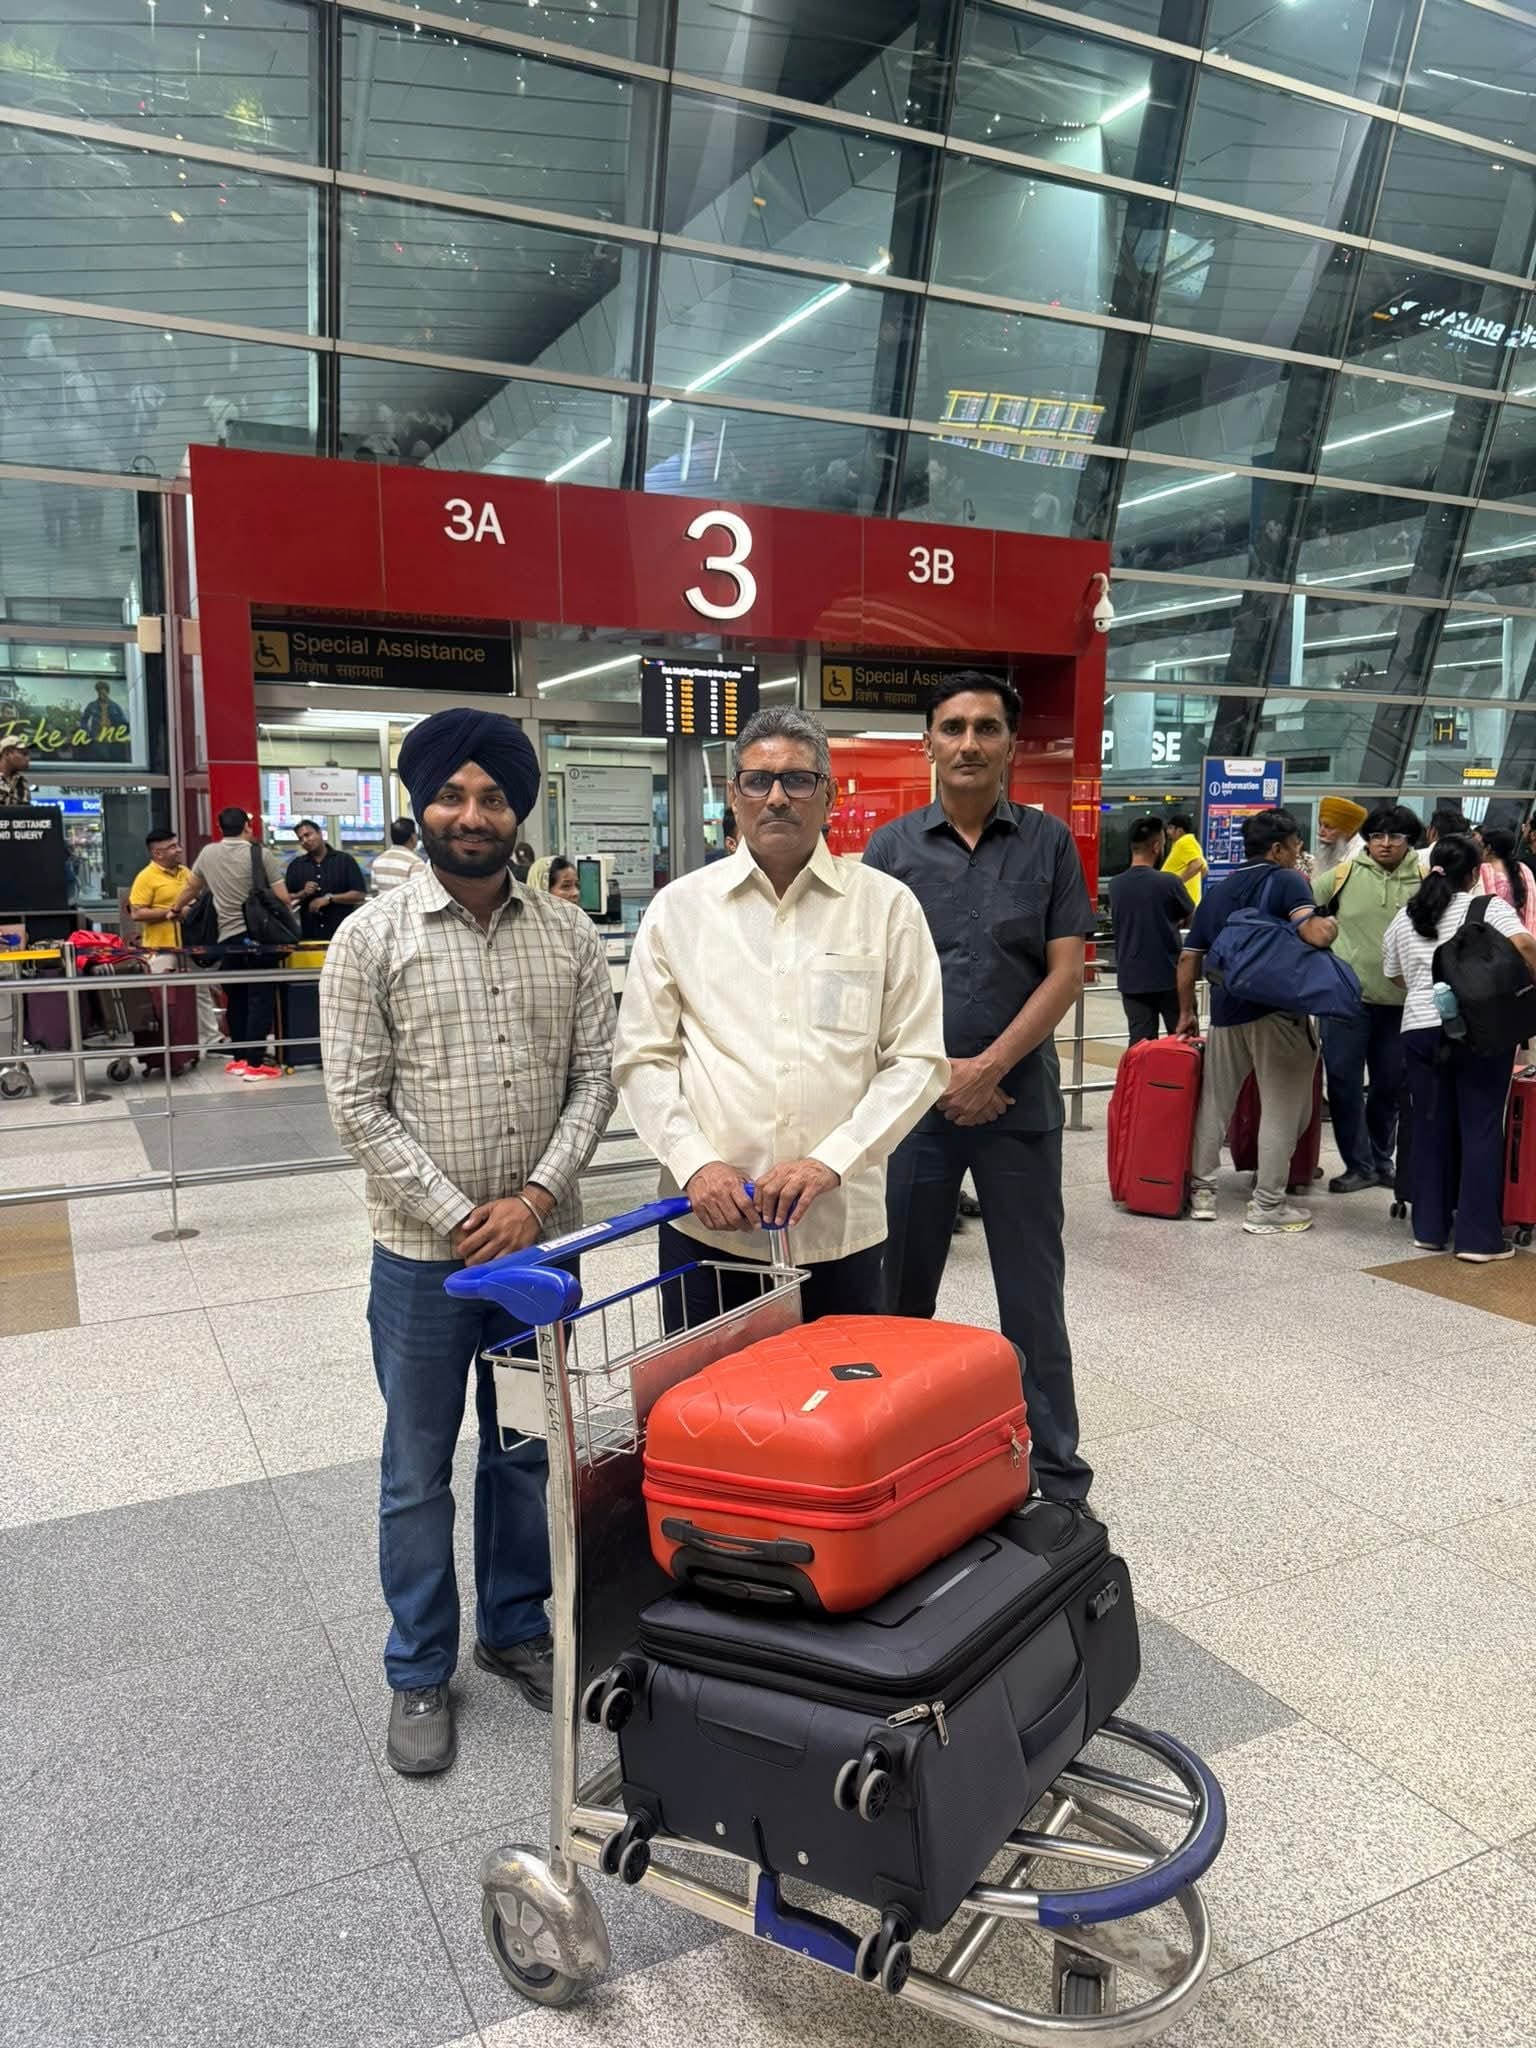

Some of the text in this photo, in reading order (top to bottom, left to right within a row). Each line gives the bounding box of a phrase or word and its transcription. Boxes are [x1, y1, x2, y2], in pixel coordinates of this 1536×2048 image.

[443, 498, 506, 545] 3A
[684, 509, 758, 620] 3
[908, 546, 955, 585] 3B
[292, 632, 486, 663] Special Assistance
[855, 667, 908, 687] Special
[0, 717, 65, 752] Take
[72, 728, 92, 746] a
[1438, 722, 1454, 742] H
[1221, 781, 1260, 790] Information
[12, 819, 52, 829] DISTANCE
[14, 830, 44, 841] QUERY
